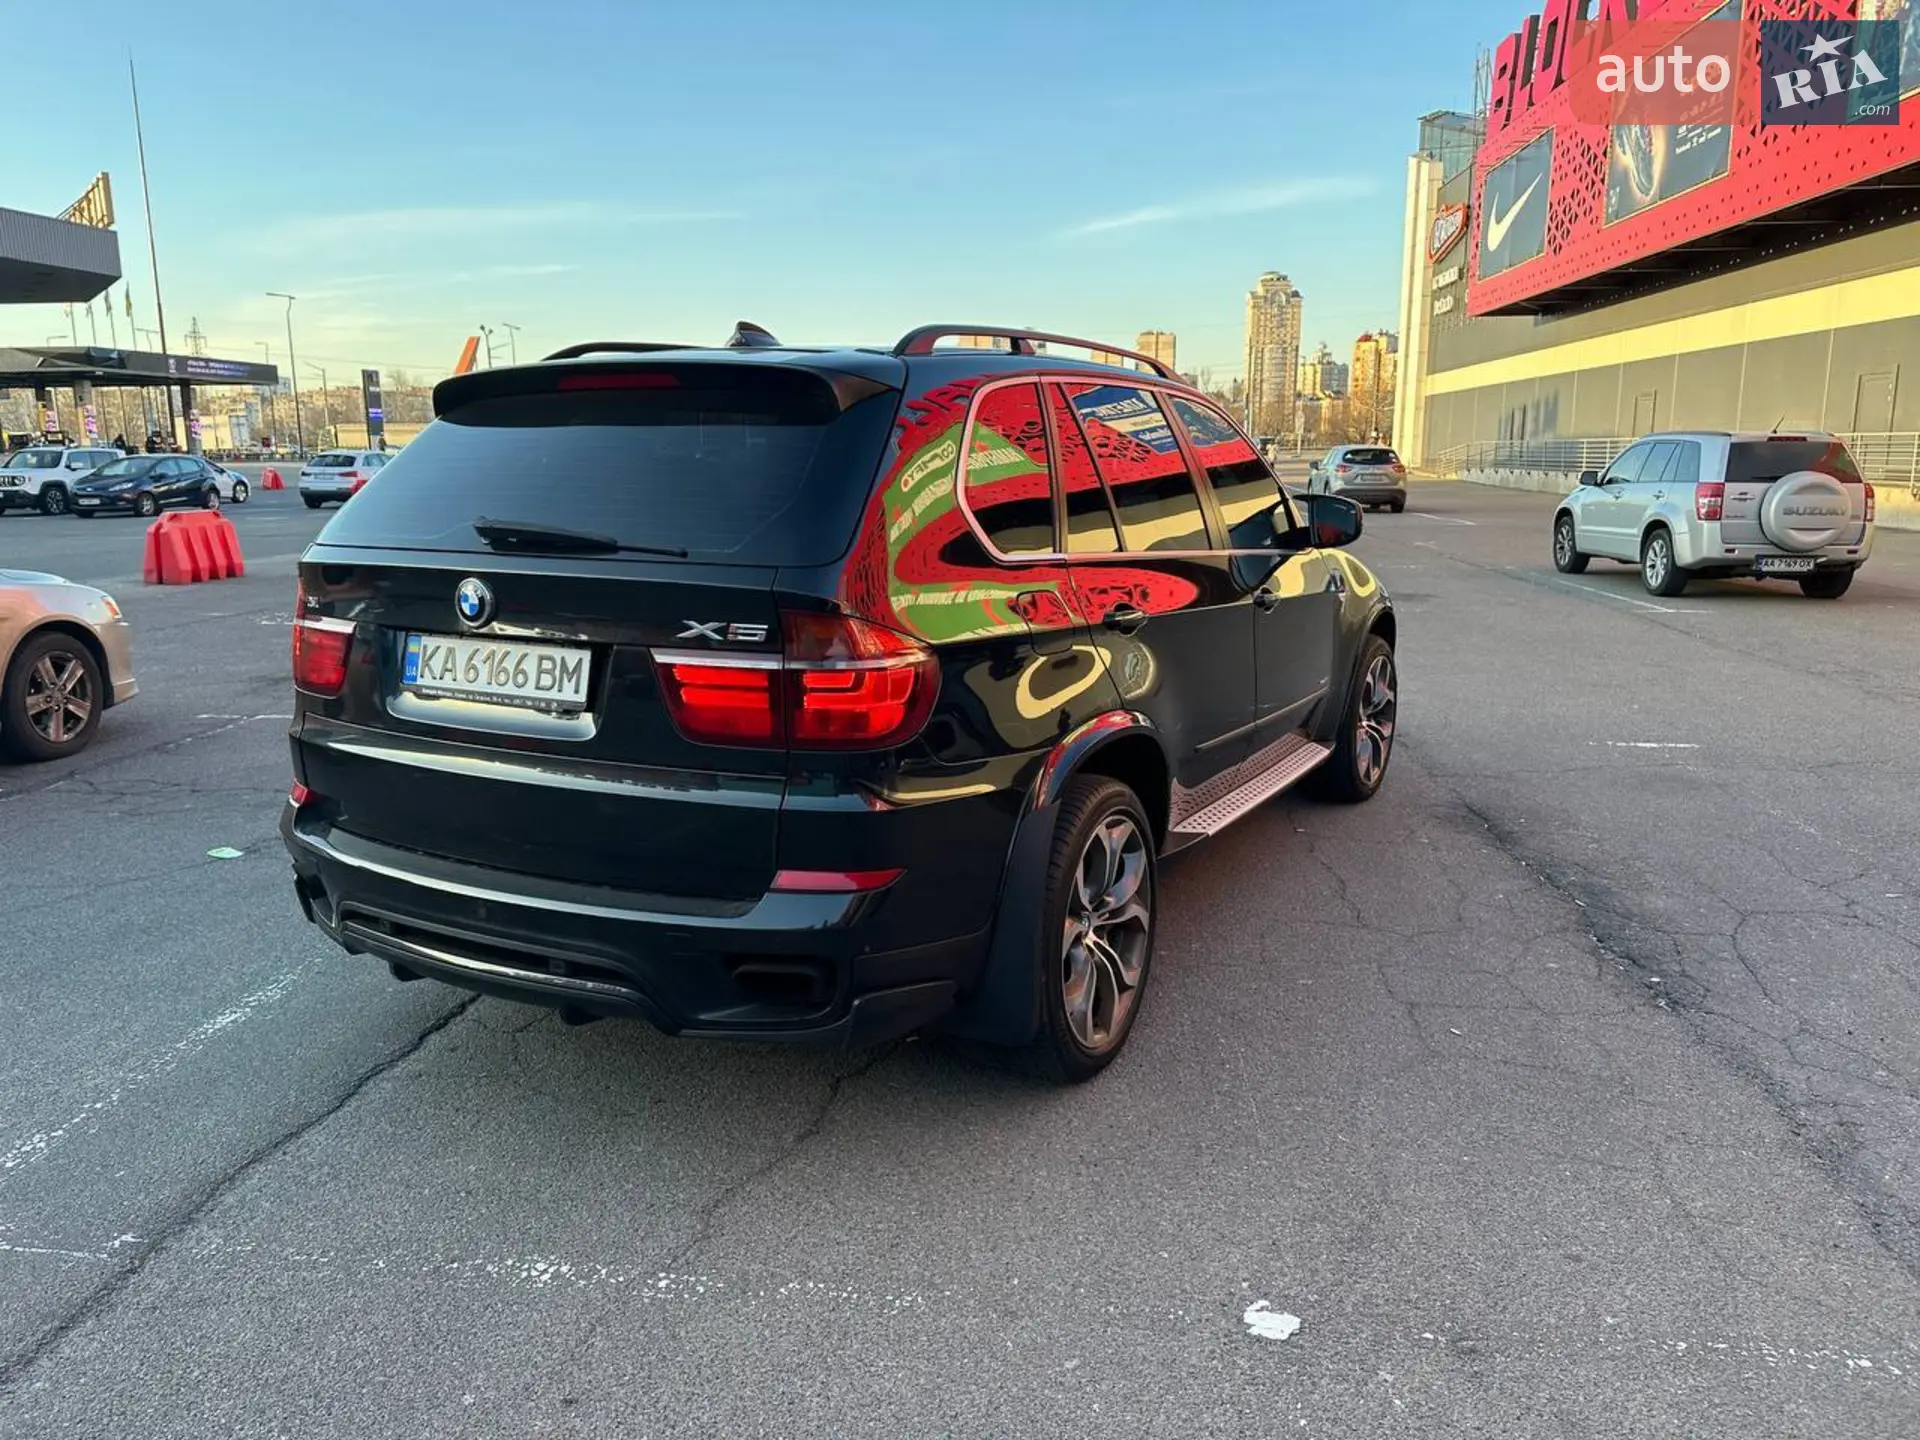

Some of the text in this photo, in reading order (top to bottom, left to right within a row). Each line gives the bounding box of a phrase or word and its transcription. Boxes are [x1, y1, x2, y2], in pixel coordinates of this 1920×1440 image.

[1782, 506, 1847, 516] SUZUKI
[676, 620, 769, 642] X5
[419, 643, 583, 695] KA 6166 BM
